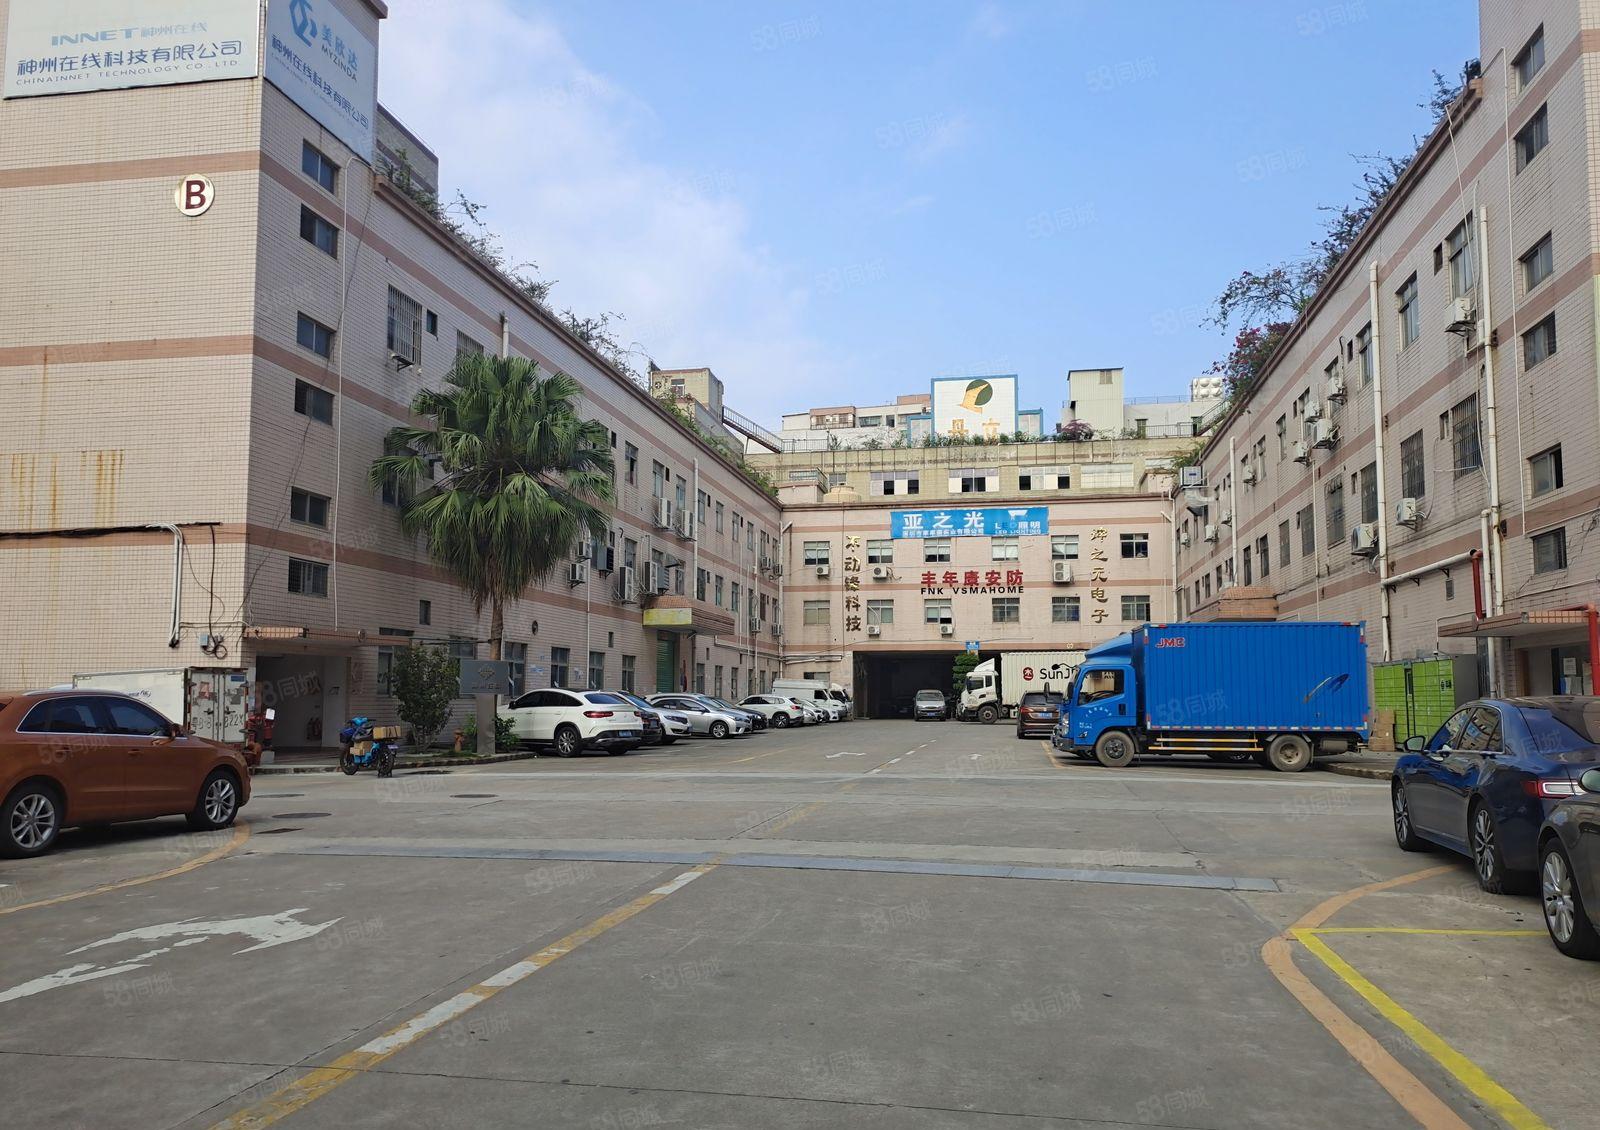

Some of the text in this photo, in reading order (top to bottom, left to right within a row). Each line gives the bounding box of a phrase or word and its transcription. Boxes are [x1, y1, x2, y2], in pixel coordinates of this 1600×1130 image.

[51, 28, 139, 46] INNET
[16, 40, 242, 76] 神州在线科技有限公司
[321, 44, 358, 82] MYZINDA
[16, 73, 90, 86] CHINAINNET
[99, 66, 179, 78] TECHNOLOGY
[271, 34, 369, 130] 神州在线科技有限公司
[185, 180, 206, 209] B
[902, 511, 984, 529] 亚之光
[921, 569, 1023, 587] 丰年康安防
[921, 586, 1024, 595] FNK VSMAHOME
[1155, 637, 1185, 648] JMC
